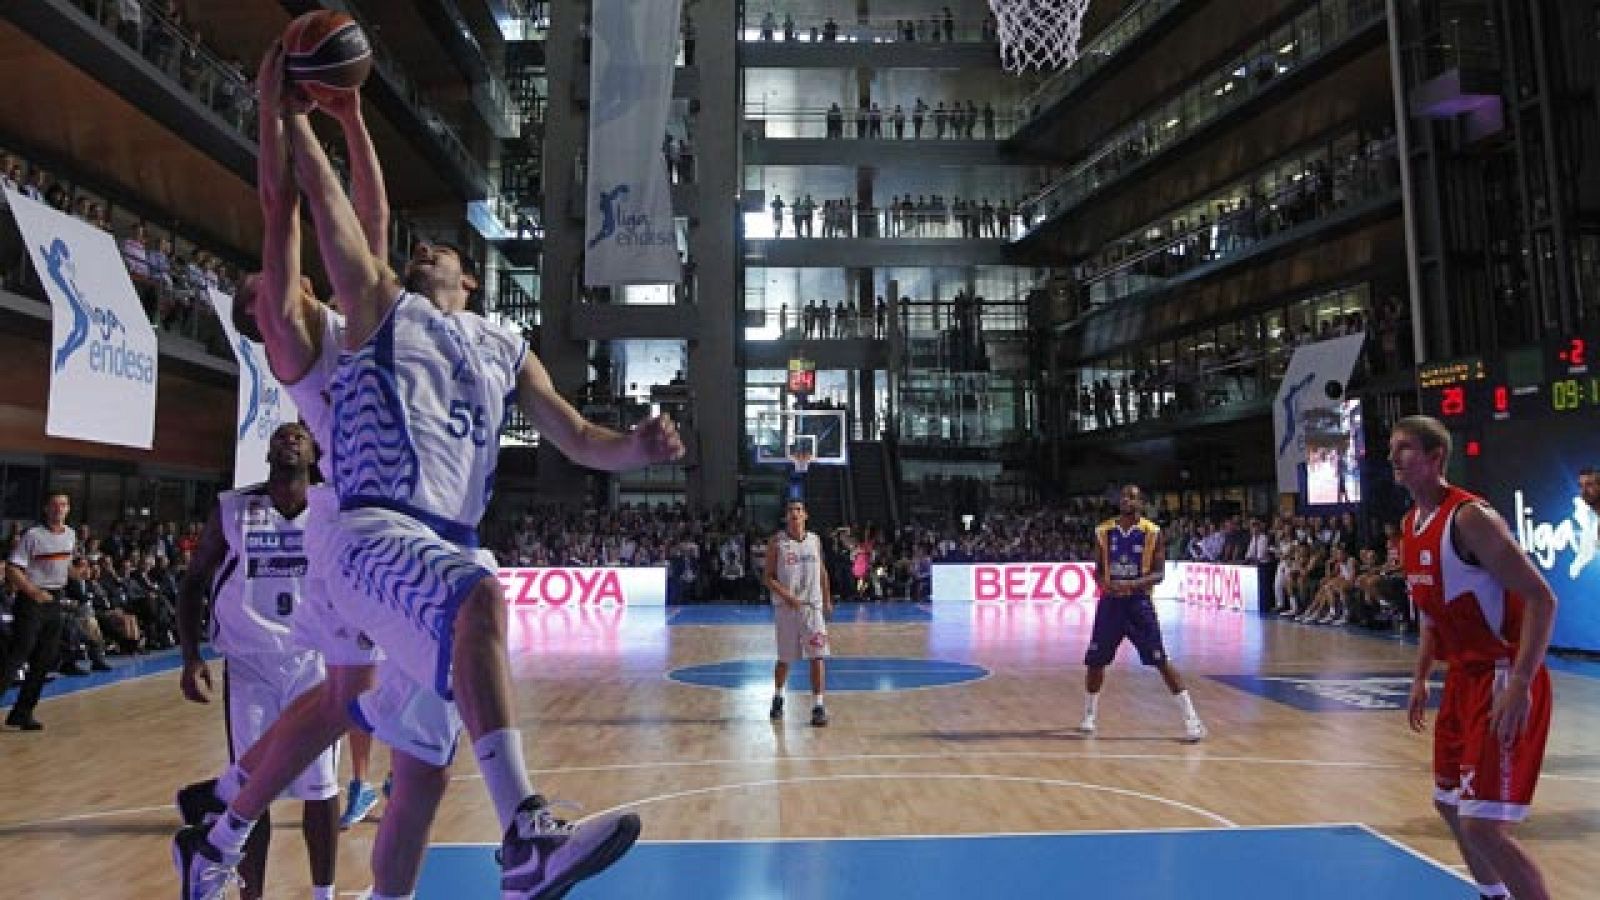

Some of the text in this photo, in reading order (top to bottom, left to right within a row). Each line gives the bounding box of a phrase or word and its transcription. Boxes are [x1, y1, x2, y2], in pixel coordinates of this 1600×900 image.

[89, 339, 153, 386] endesa
[1514, 489, 1576, 569] liga
[497, 569, 625, 606] EZOYA
[974, 564, 1104, 601] BEZOY
